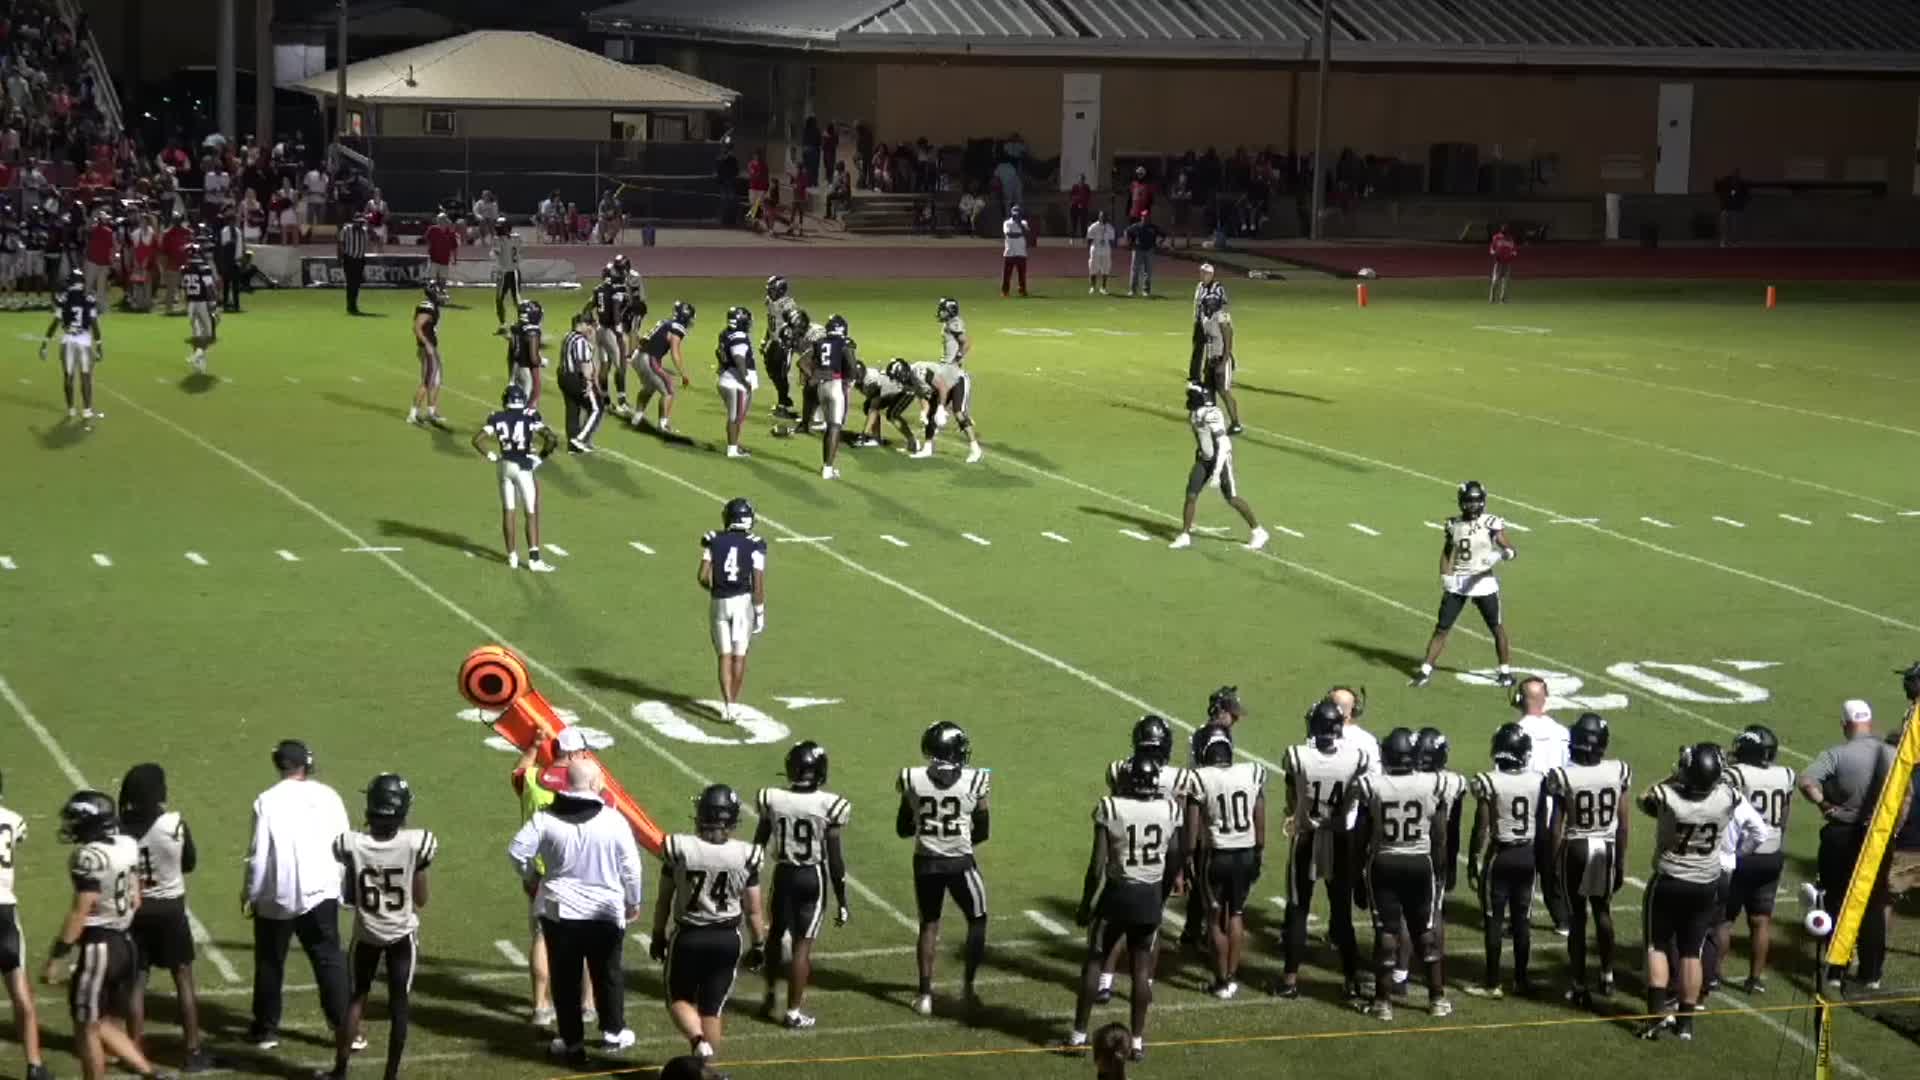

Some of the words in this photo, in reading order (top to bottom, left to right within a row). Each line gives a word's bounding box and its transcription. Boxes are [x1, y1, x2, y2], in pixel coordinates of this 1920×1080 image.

[71, 306, 83, 327] 3
[821, 343, 832, 366] 2
[496, 421, 525, 450] 24
[724, 546, 739, 581] 4
[1459, 539, 1472, 561] 8
[919, 796, 962, 836] 22
[1217, 790, 1250, 834] 10
[1311, 781, 1344, 818] 14
[1512, 796, 1529, 835] 9
[1576, 787, 1616, 829] 88
[778, 817, 815, 861] 19
[1382, 800, 1422, 842] 52
[1675, 822, 1718, 855] 73
[1126, 824, 1162, 866] 12
[360, 866, 404, 914] 65
[686, 871, 728, 912] 74
